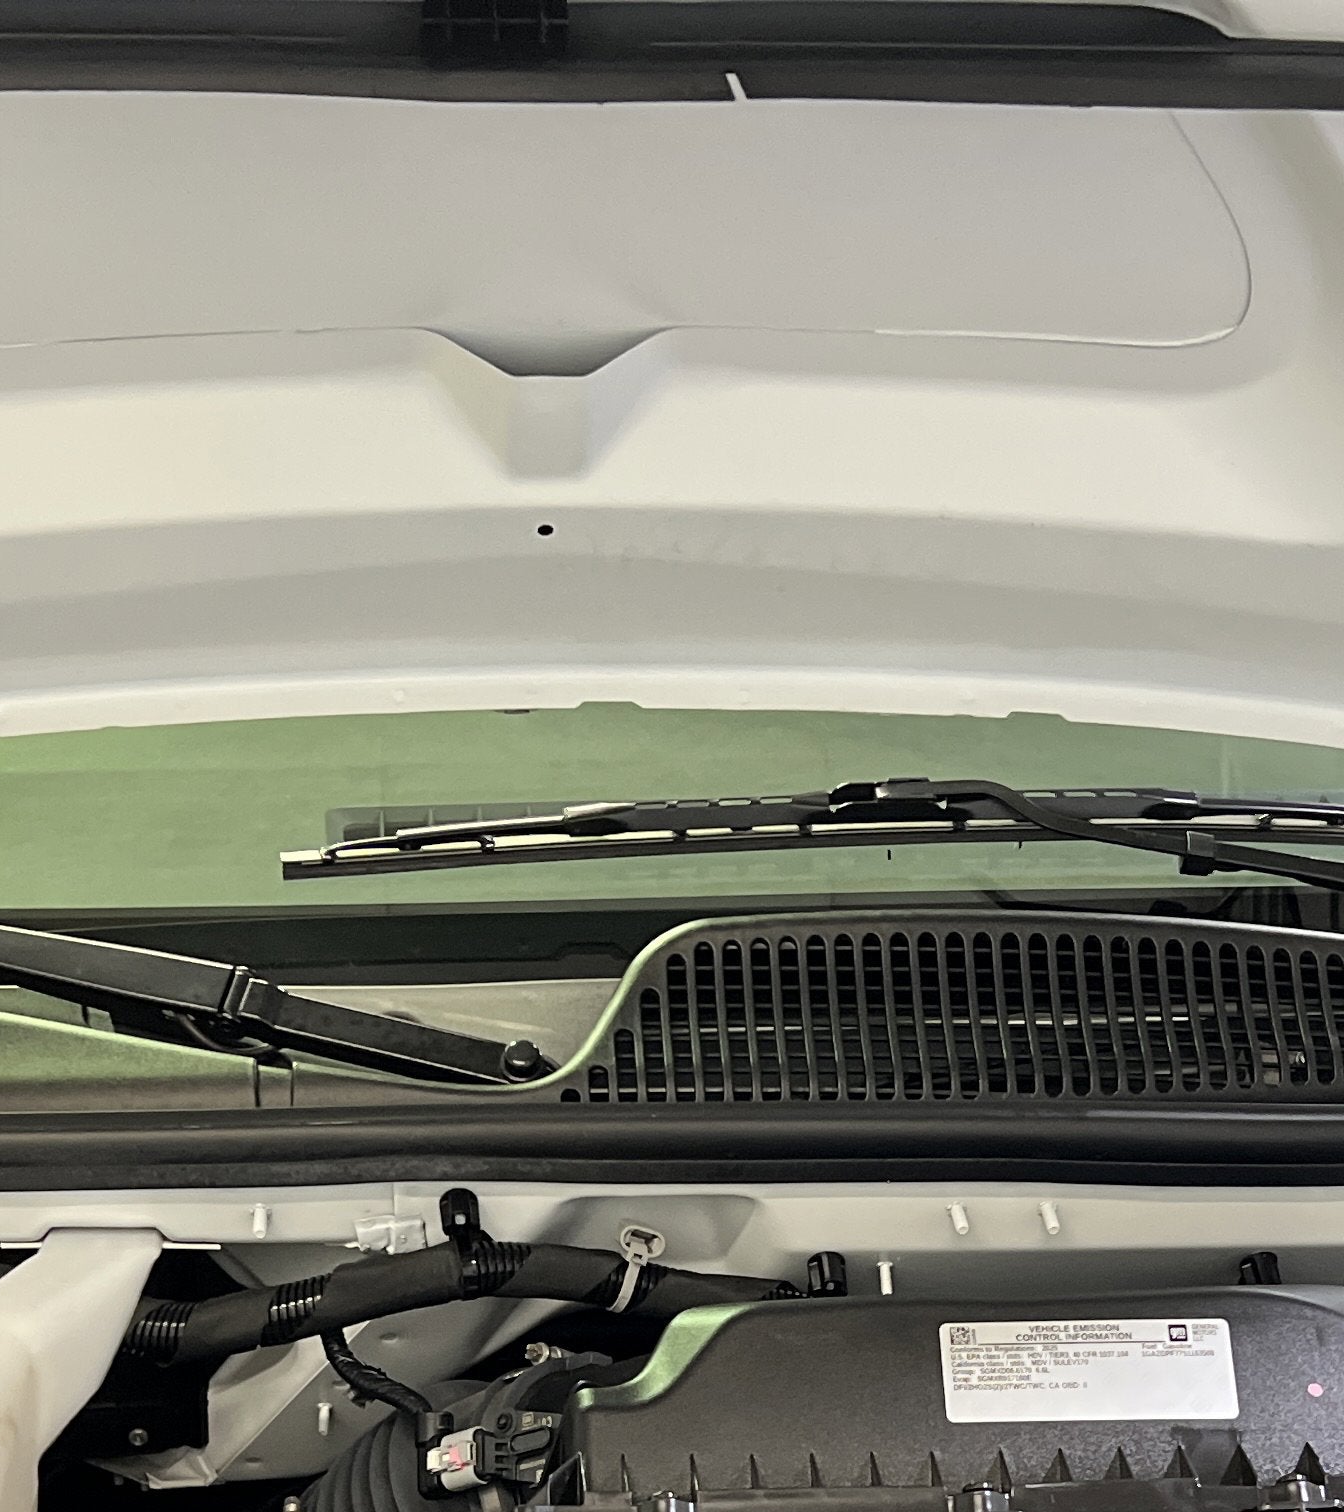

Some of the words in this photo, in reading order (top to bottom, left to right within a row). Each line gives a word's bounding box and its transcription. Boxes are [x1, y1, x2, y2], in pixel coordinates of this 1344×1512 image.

[1028, 1325, 1070, 1333] VEHICLE
[1073, 1323, 1120, 1331] EMISSION
[1015, 1333, 1062, 1341] CONTROL
[1065, 1332, 1133, 1340] INFORMATION
